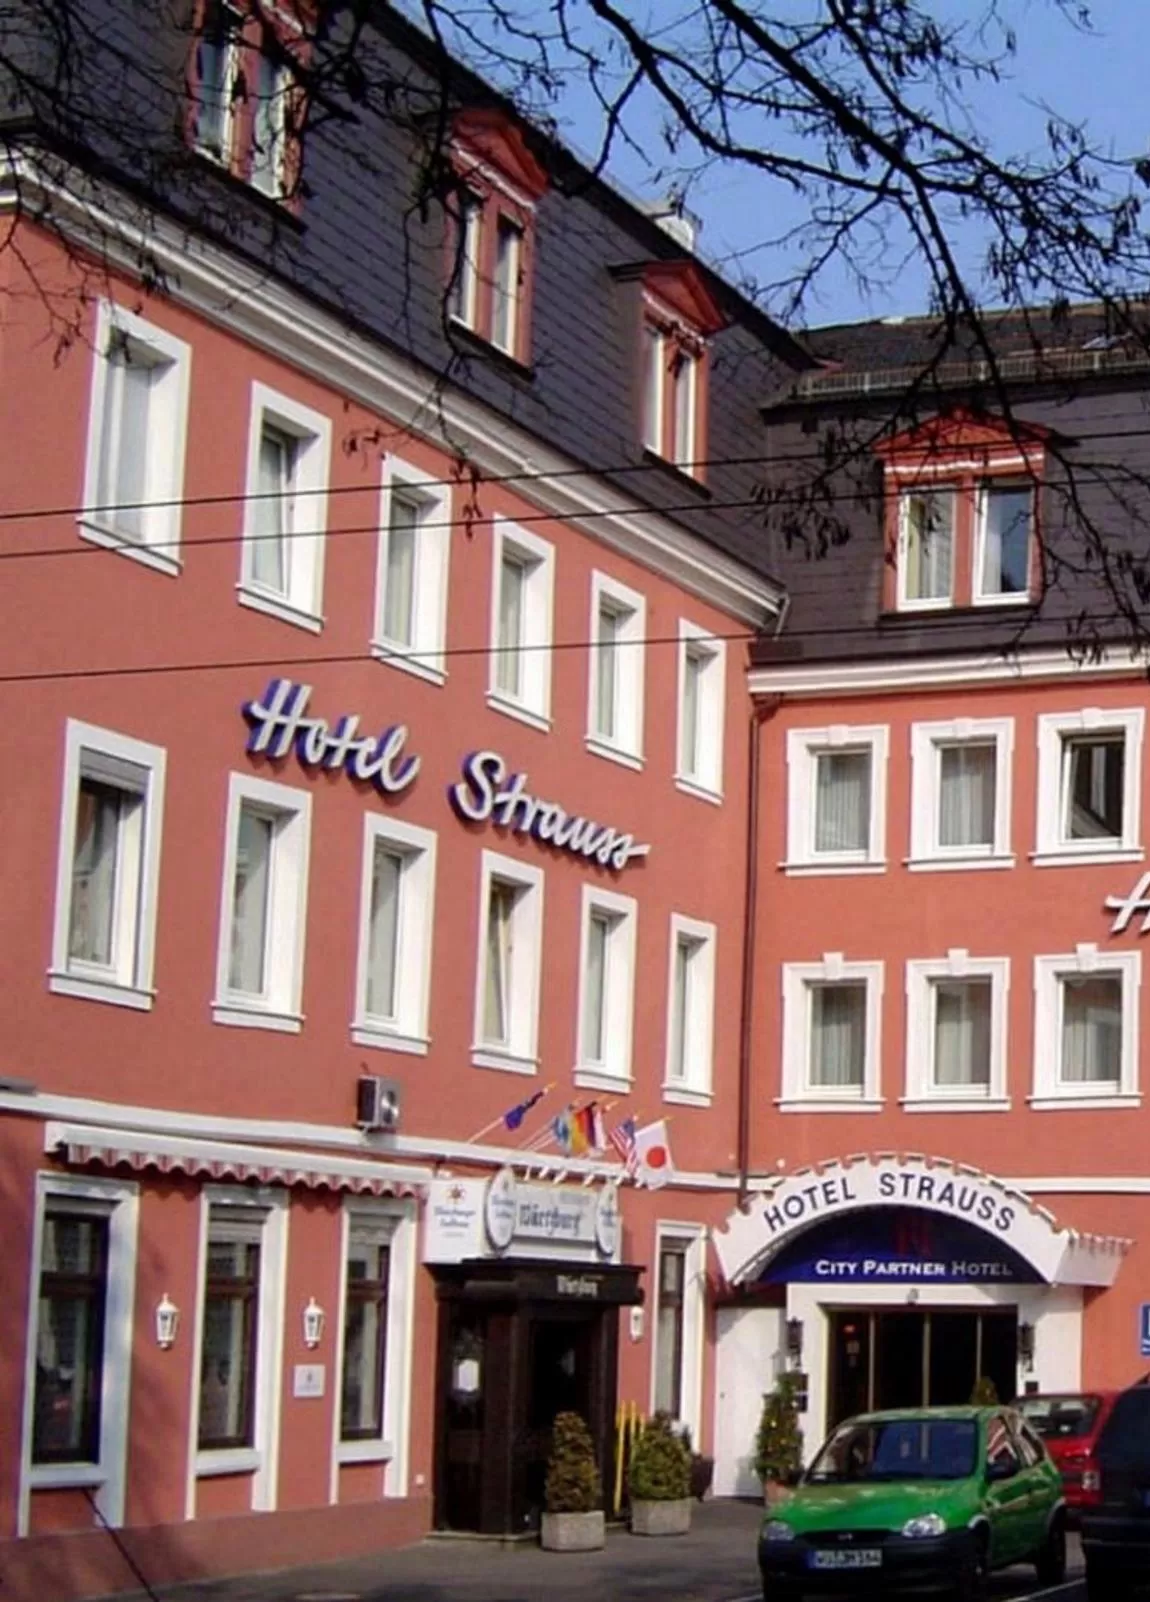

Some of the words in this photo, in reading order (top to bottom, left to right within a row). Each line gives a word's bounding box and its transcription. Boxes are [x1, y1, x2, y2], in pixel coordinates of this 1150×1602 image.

[243, 678, 420, 794] Hotel
[448, 749, 652, 872] Strauss
[763, 1176, 857, 1233] HOTEL
[879, 1172, 1015, 1232] STRAUSS
[815, 1259, 858, 1276] CITY
[863, 1259, 946, 1277] PARTNER
[951, 1259, 1013, 1277] HOTEL
